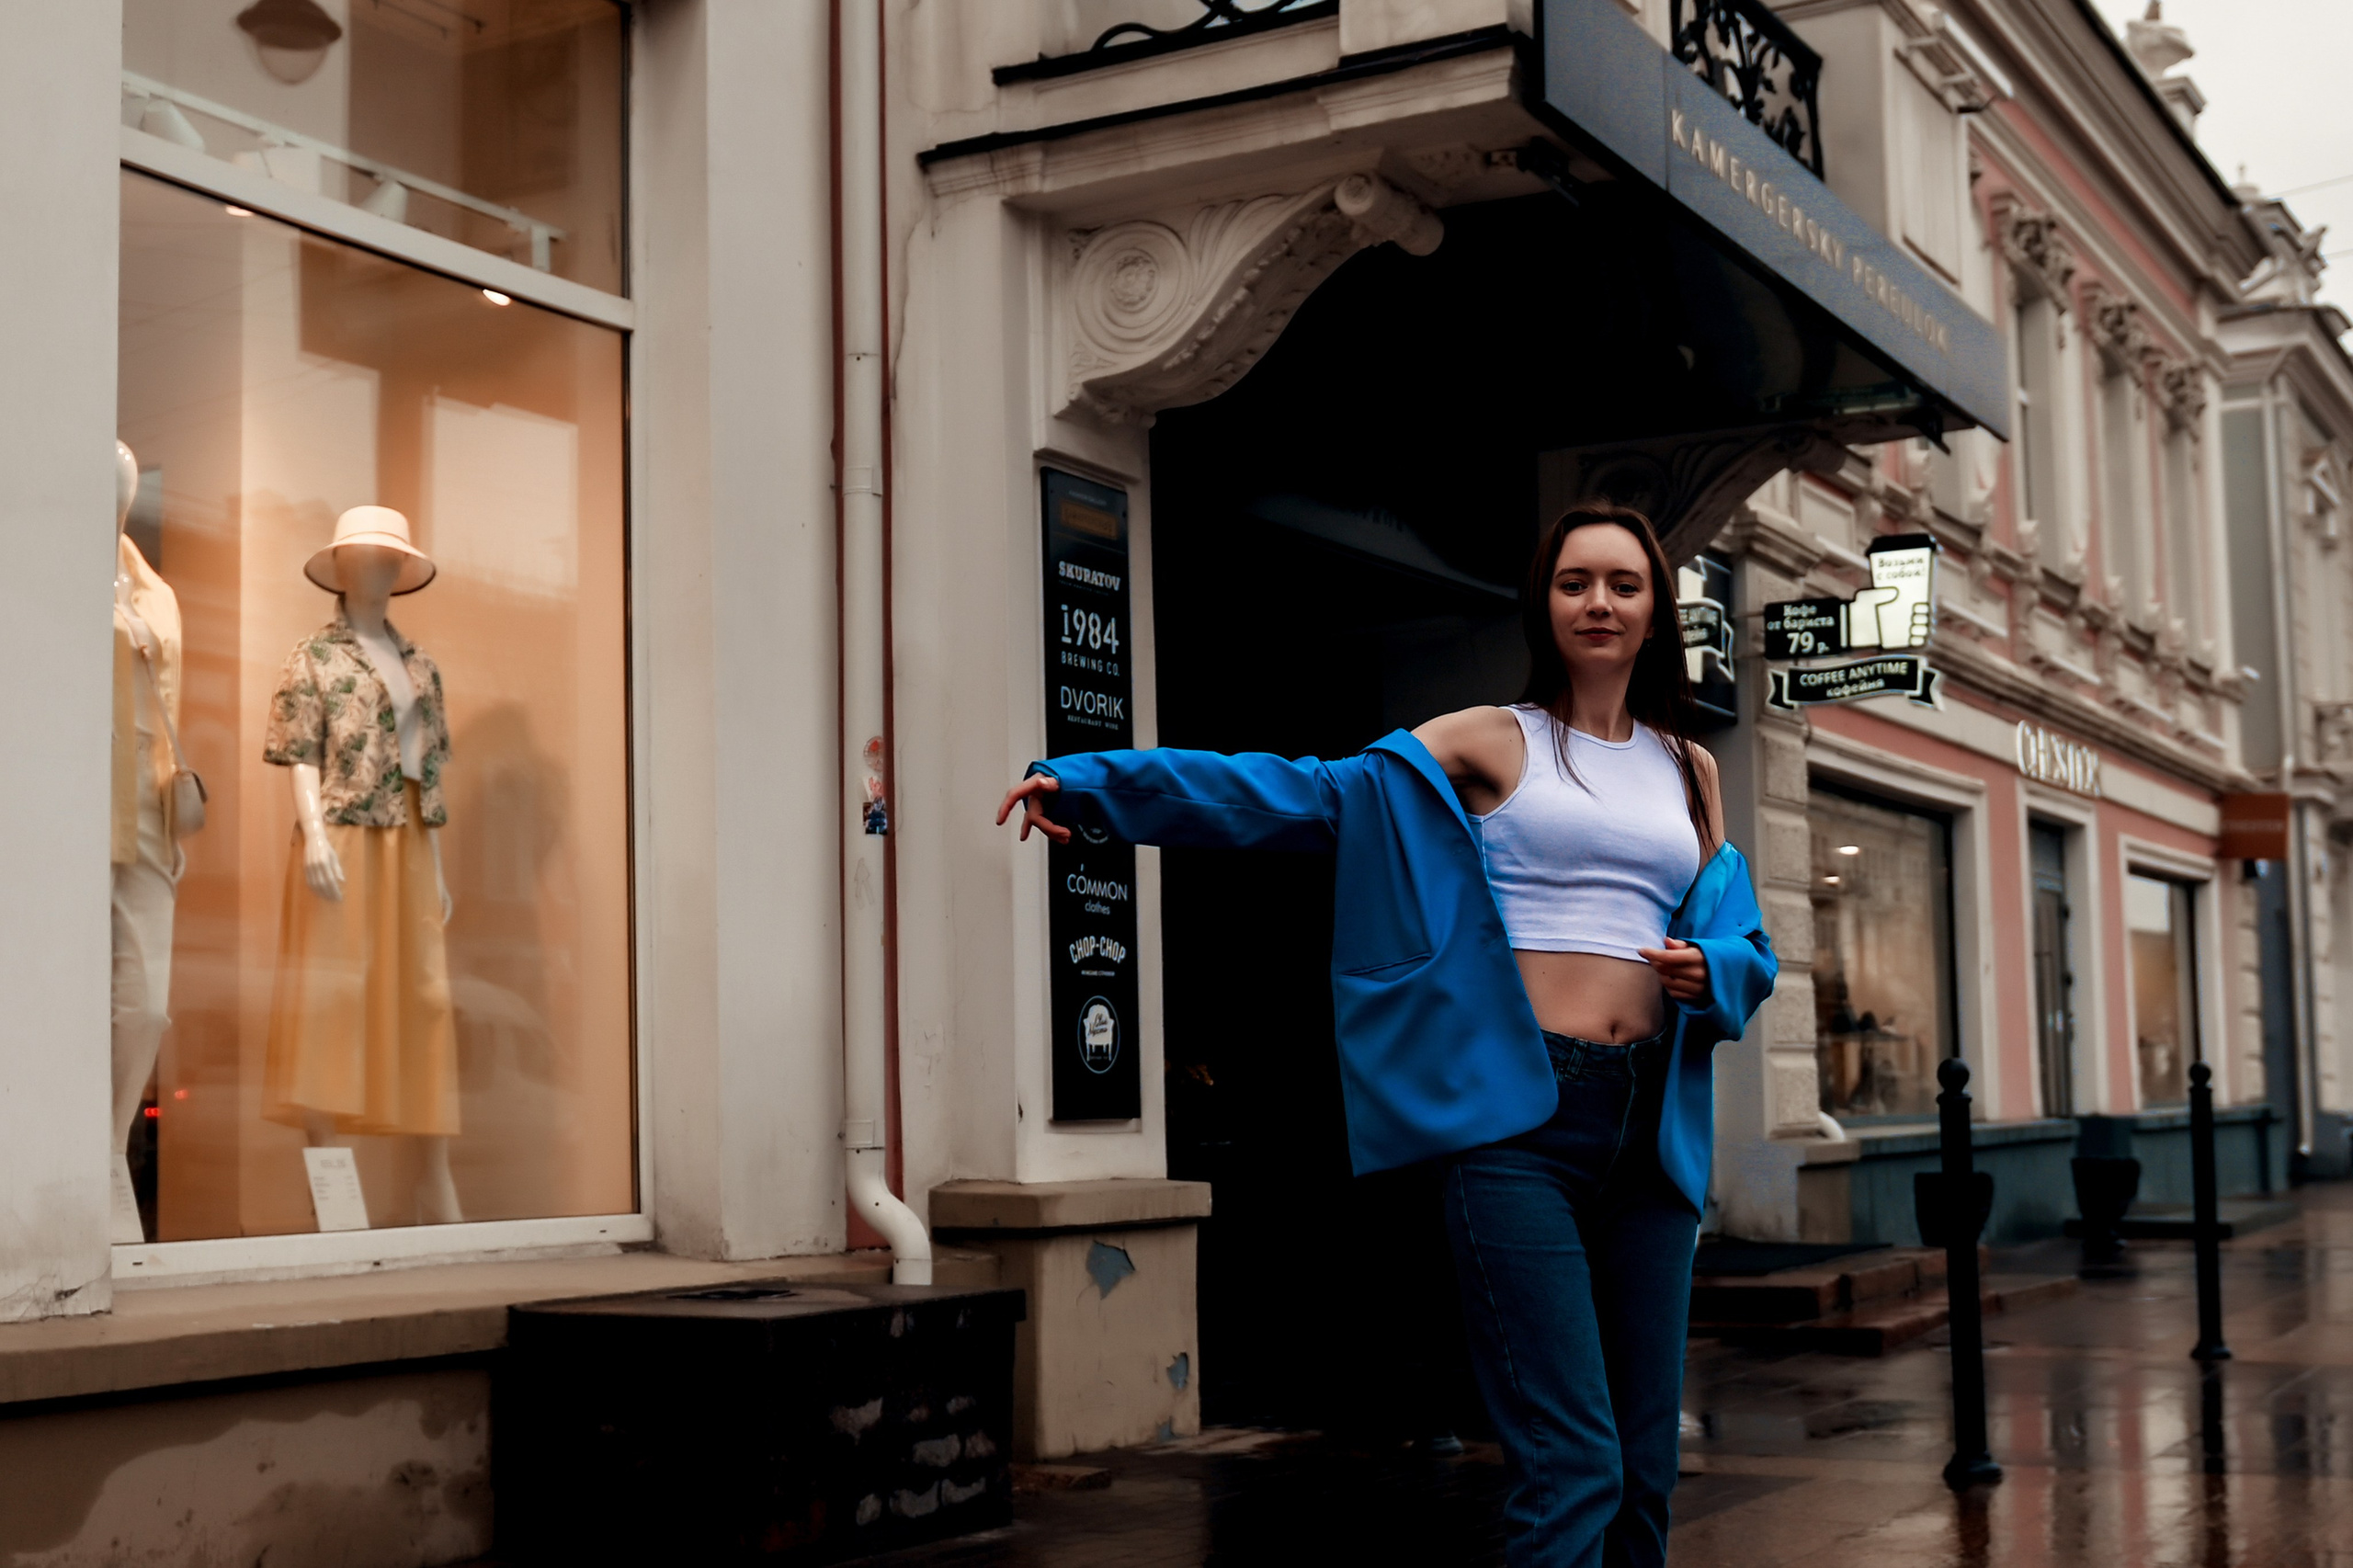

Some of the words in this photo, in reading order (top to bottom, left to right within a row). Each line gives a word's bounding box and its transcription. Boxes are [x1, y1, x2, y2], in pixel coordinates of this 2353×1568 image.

[1670, 108, 1844, 268] KAMERGERSKY
[1059, 561, 1120, 591] SKURATOV
[1783, 604, 1817, 618] Кофе
[1061, 604, 1120, 654] 1984
[1787, 631, 1814, 654] 79
[1061, 651, 1103, 673] BREWING
[1106, 662, 1120, 676] CO.
[1799, 669, 1847, 687] COFFEE
[1848, 661, 1909, 680] ANYTIME
[1061, 685, 1124, 720] DVORIK
[1069, 935, 1127, 964] CHOP-CHOP
